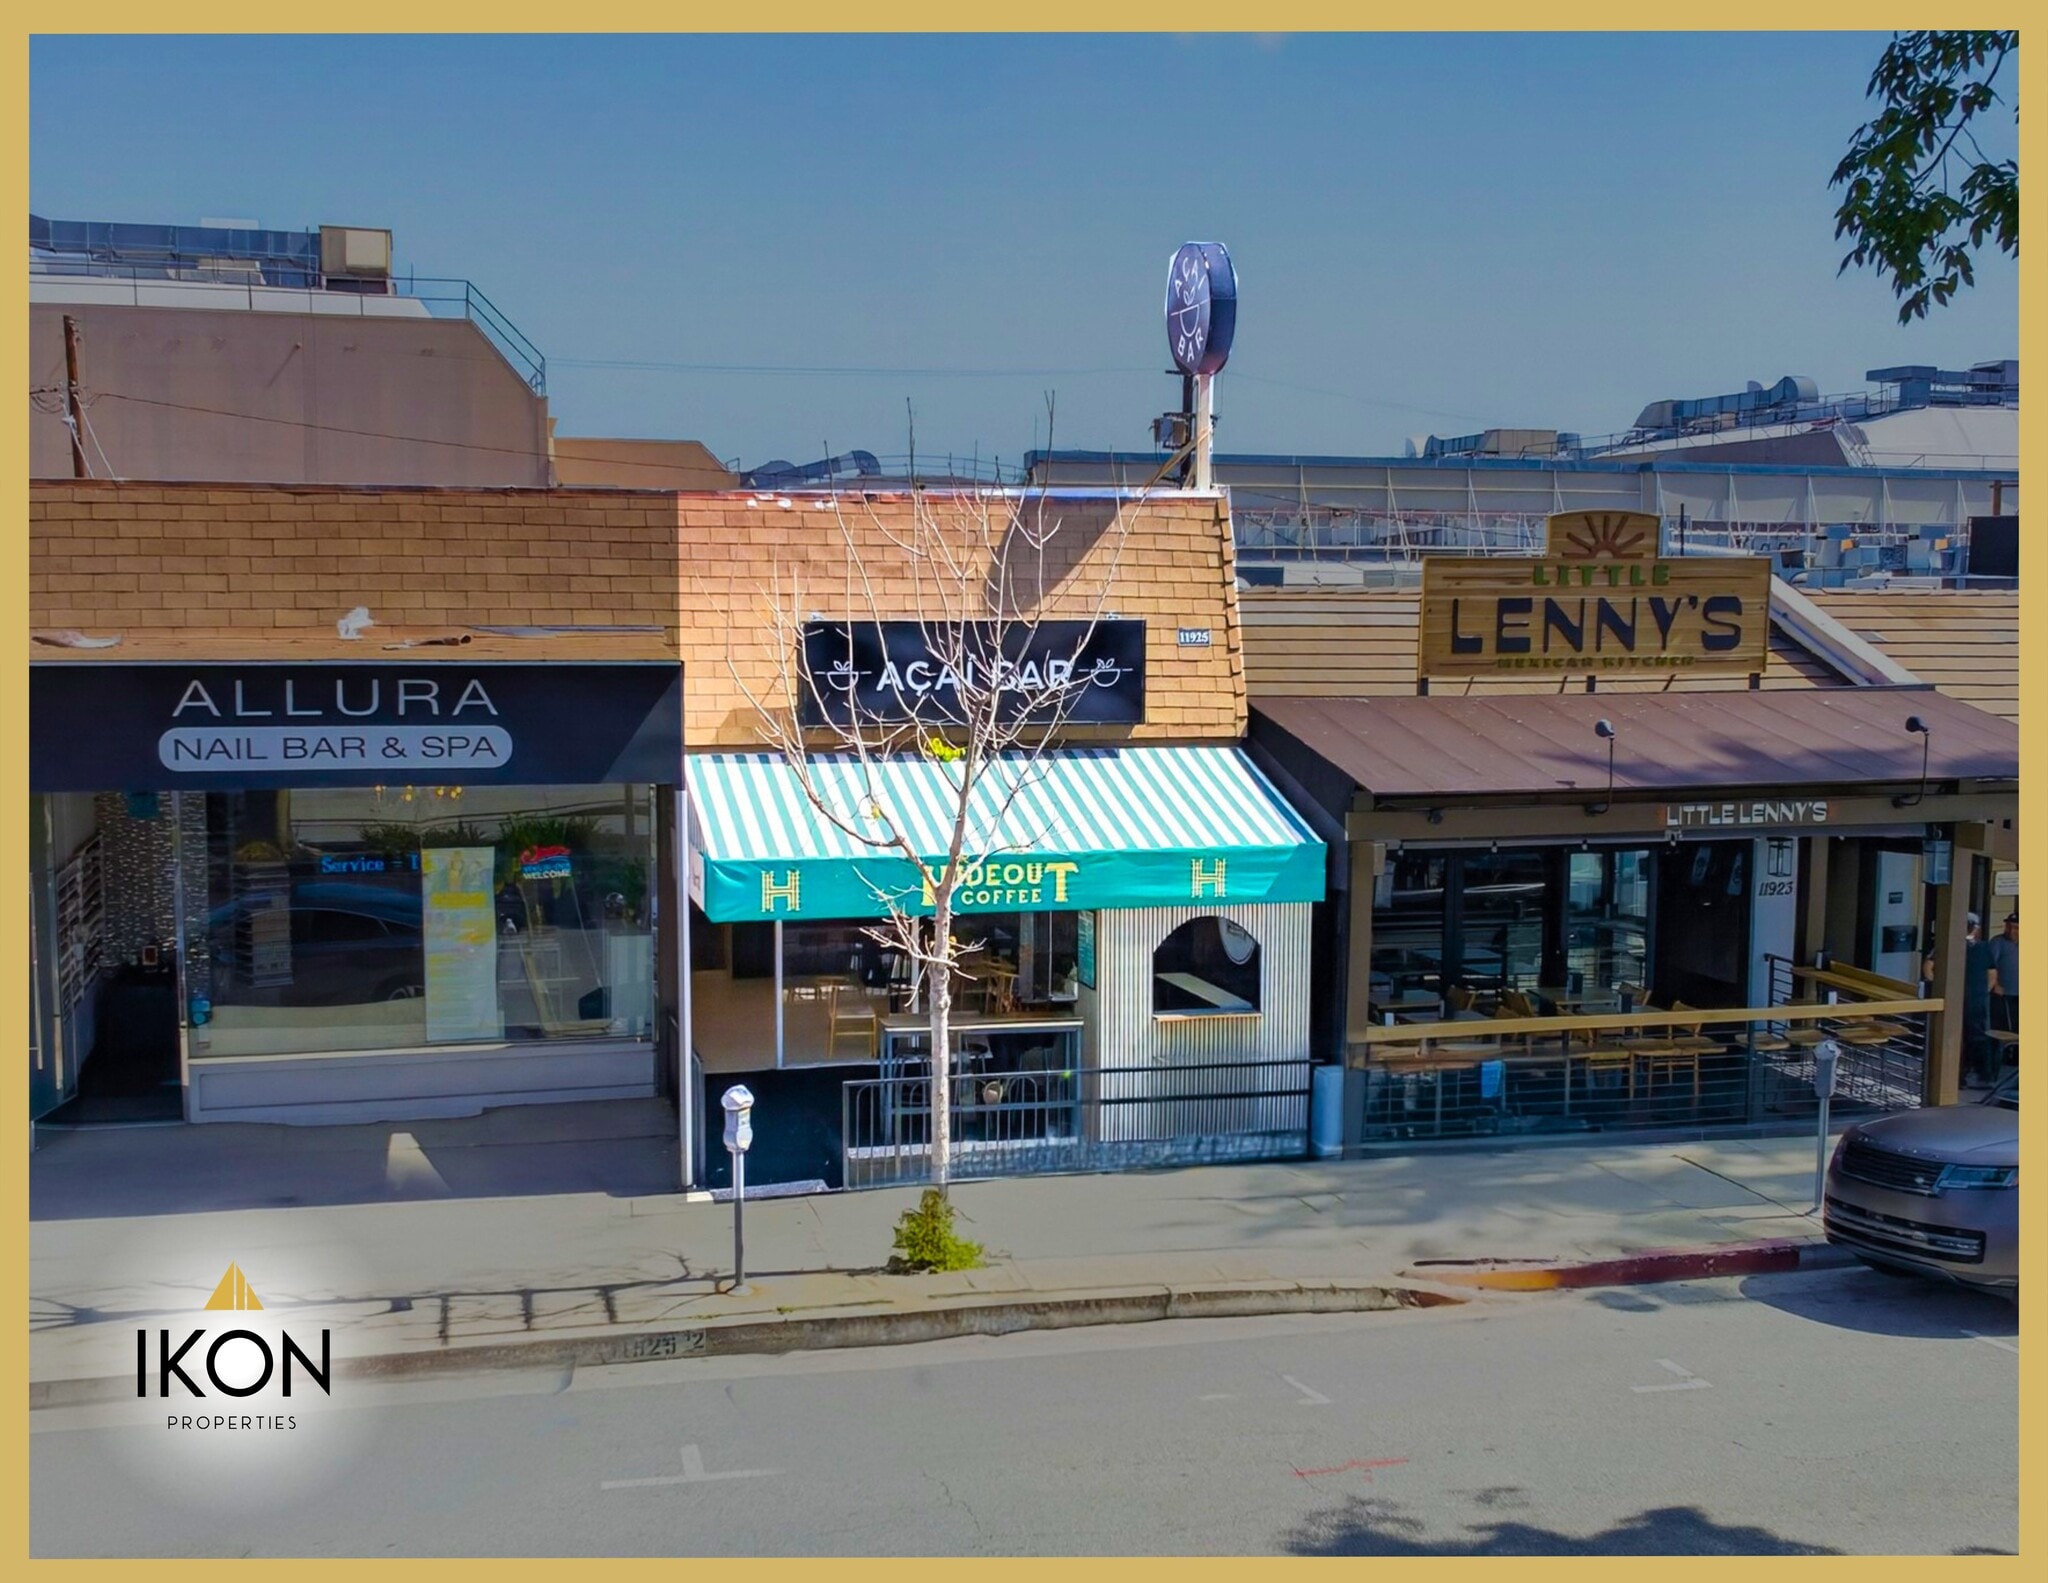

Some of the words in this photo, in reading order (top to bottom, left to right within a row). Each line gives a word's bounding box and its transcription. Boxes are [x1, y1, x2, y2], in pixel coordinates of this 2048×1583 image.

[1177, 327, 1203, 363] BAR
[1532, 564, 1671, 586] LITTLE
[1179, 631, 1209, 643] 11925
[1451, 594, 1743, 655] LENNY'S
[993, 660, 1073, 690] BAR
[172, 678, 499, 717] ALLURA
[173, 737, 268, 760] NAIL
[283, 737, 366, 759] BAR
[381, 736, 407, 758] &
[421, 735, 498, 758] SPA
[1667, 803, 1735, 826] LITTLE
[1739, 800, 1828, 823] LENNY'S
[320, 854, 386, 873] Service
[761, 870, 800, 912] H
[1191, 858, 1226, 898] H
[1758, 881, 1793, 896] 11923
[961, 888, 1042, 905] COFFEE
